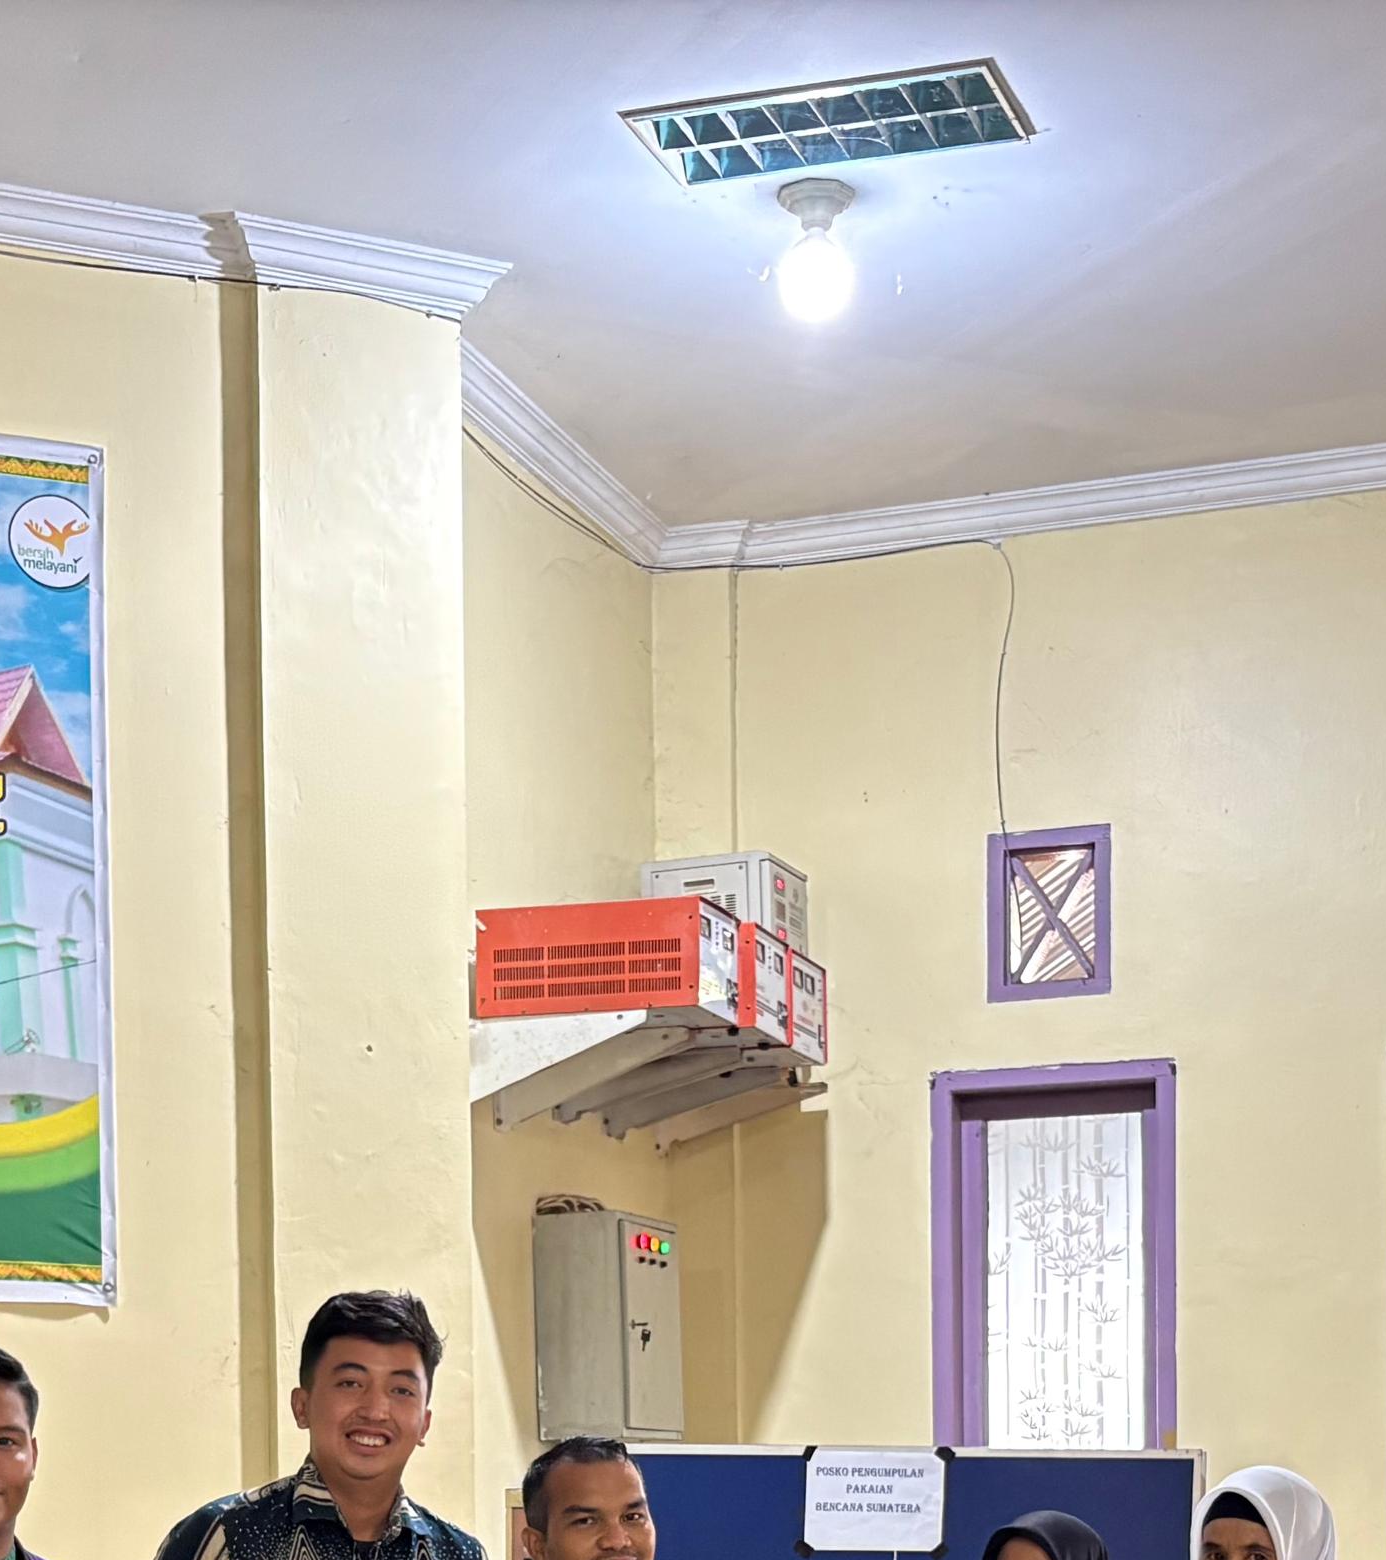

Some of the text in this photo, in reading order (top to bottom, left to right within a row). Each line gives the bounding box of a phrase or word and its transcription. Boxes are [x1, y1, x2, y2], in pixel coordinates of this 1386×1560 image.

[17, 543, 54, 561] bersih
[23, 556, 78, 575] melayani
[815, 1466, 925, 1479] POSKO PENGUMPULAN
[845, 1483, 894, 1495] PAKAIAN
[814, 1501, 922, 1514] BENCANA SUMATERA
